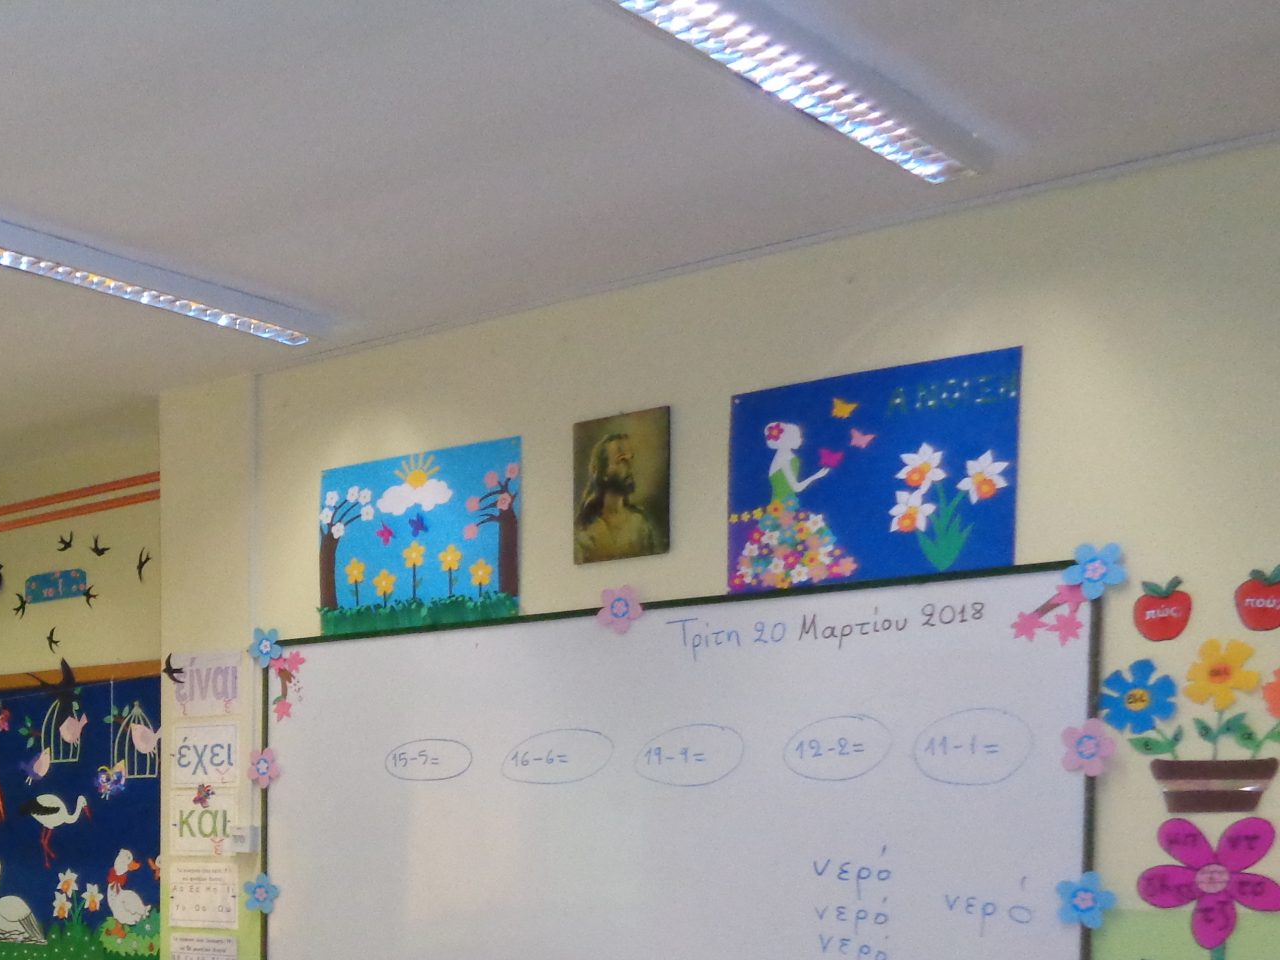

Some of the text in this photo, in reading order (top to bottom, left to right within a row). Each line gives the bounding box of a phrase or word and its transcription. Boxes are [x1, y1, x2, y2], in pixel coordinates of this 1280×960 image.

[666, 602, 985, 662] Τρίτη 20 Μαρτίου 2018
[177, 736, 234, 775] έχει
[392, 750, 439, 767] 15-5=
[511, 749, 568, 767] 16-6=
[178, 809, 232, 839] και
[813, 844, 891, 900] νερό
[815, 896, 889, 936] νερό
[945, 876, 1033, 938] νερό
